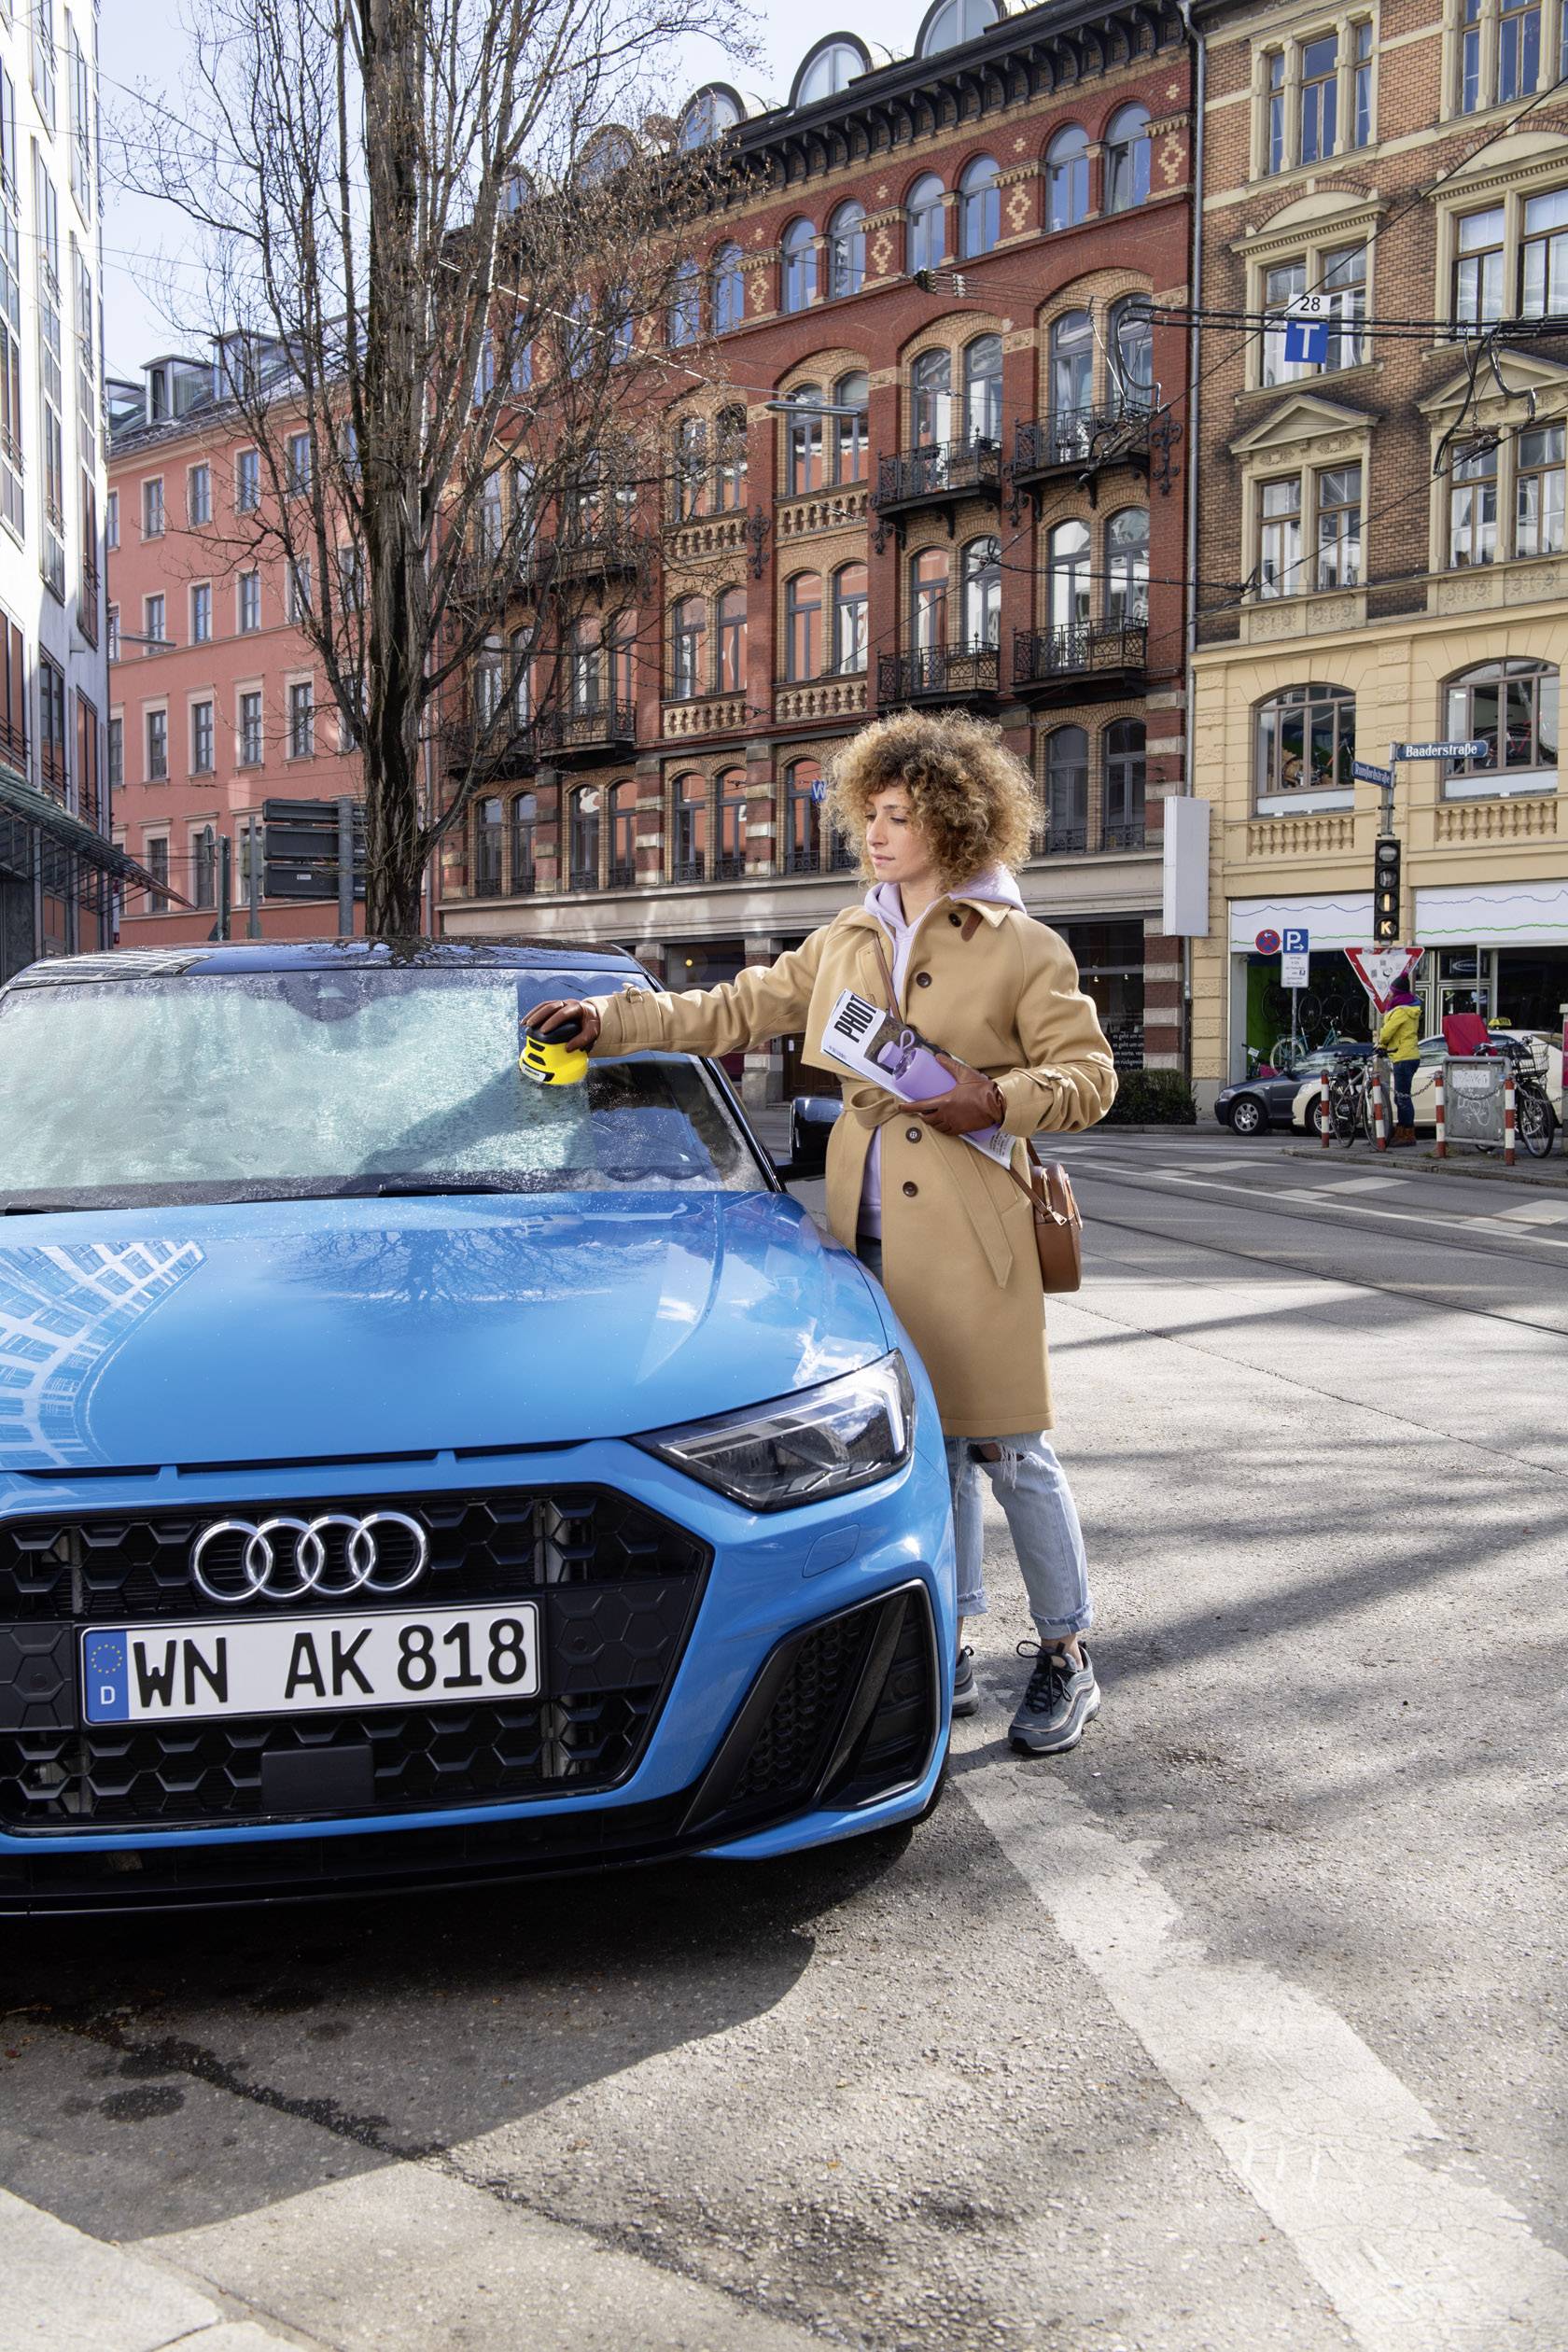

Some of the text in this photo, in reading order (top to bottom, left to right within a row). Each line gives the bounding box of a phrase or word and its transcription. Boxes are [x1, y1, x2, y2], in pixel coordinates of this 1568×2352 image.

[1300, 296, 1321, 312] 28
[1295, 323, 1320, 359] T
[1405, 743, 1477, 758] Baaderstraße
[1380, 921, 1392, 934] K
[1286, 931, 1302, 951] P
[133, 1617, 527, 1709] WN AK 818
[100, 1686, 116, 1705] D
